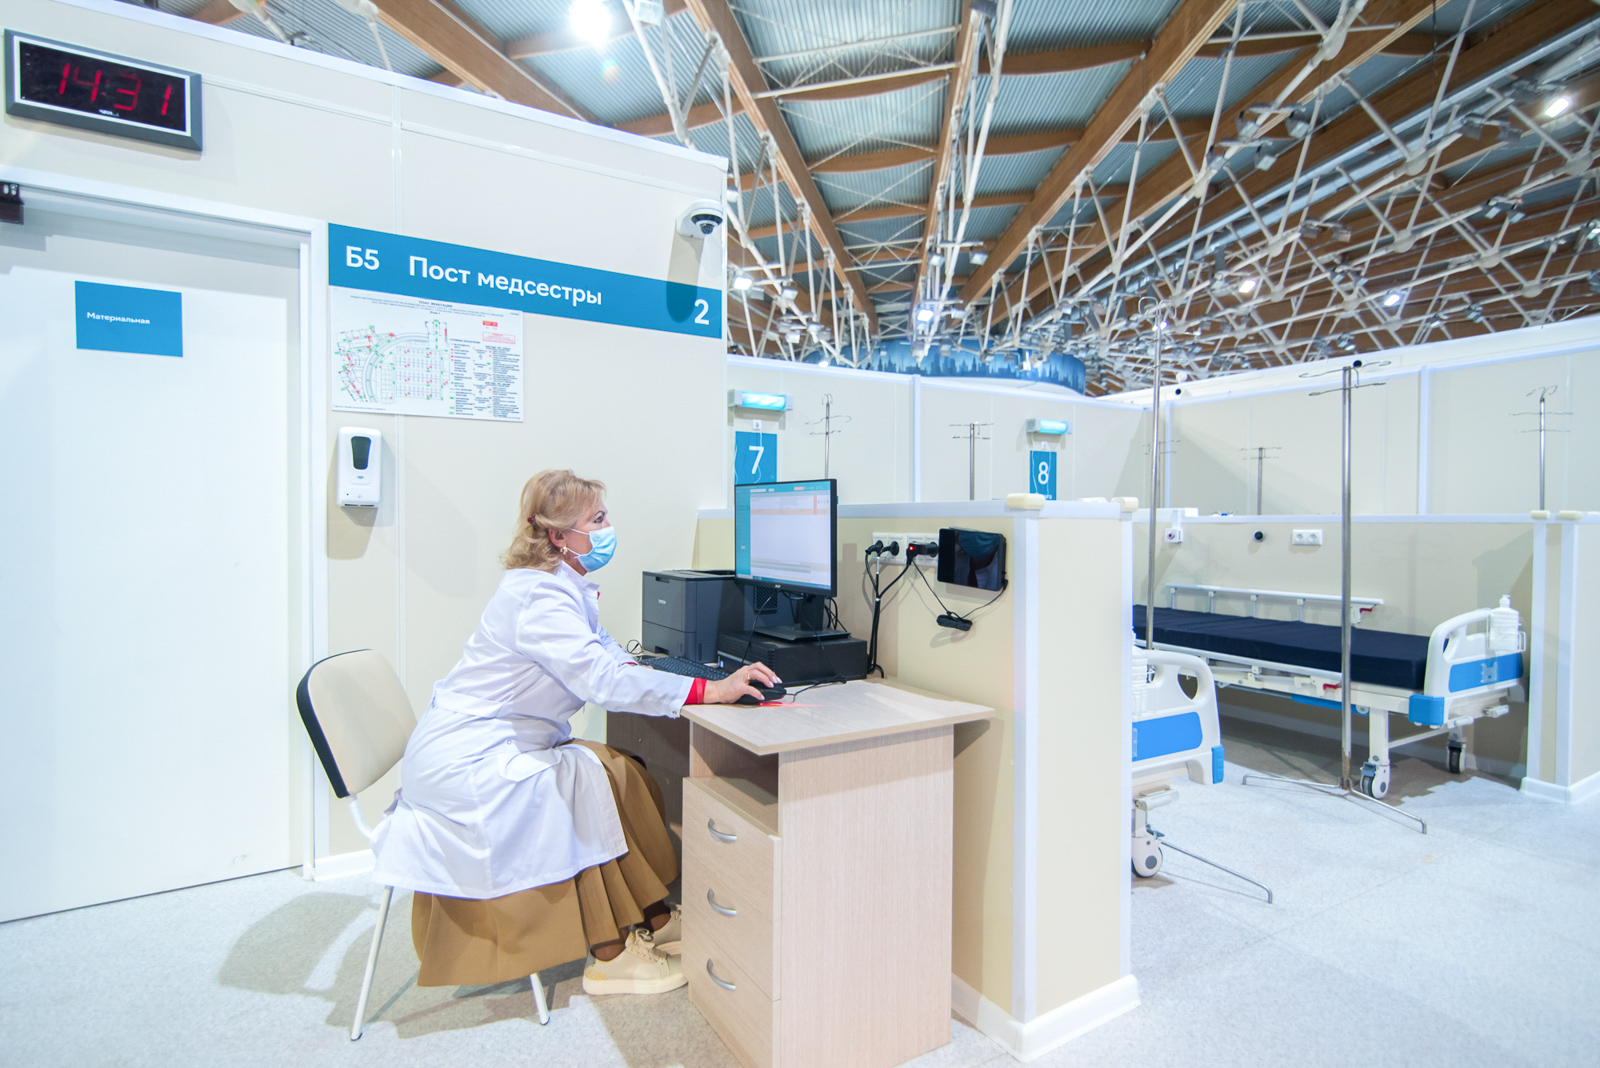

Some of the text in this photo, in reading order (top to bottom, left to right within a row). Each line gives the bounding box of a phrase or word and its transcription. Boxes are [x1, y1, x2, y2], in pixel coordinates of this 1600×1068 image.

[59, 63, 171, 116] 14:31
[347, 246, 709, 325] Б5 Пост медсестры 2
[87, 312, 150, 324] Материальная
[749, 444, 764, 474] 7
[1038, 462, 1050, 484] 8
